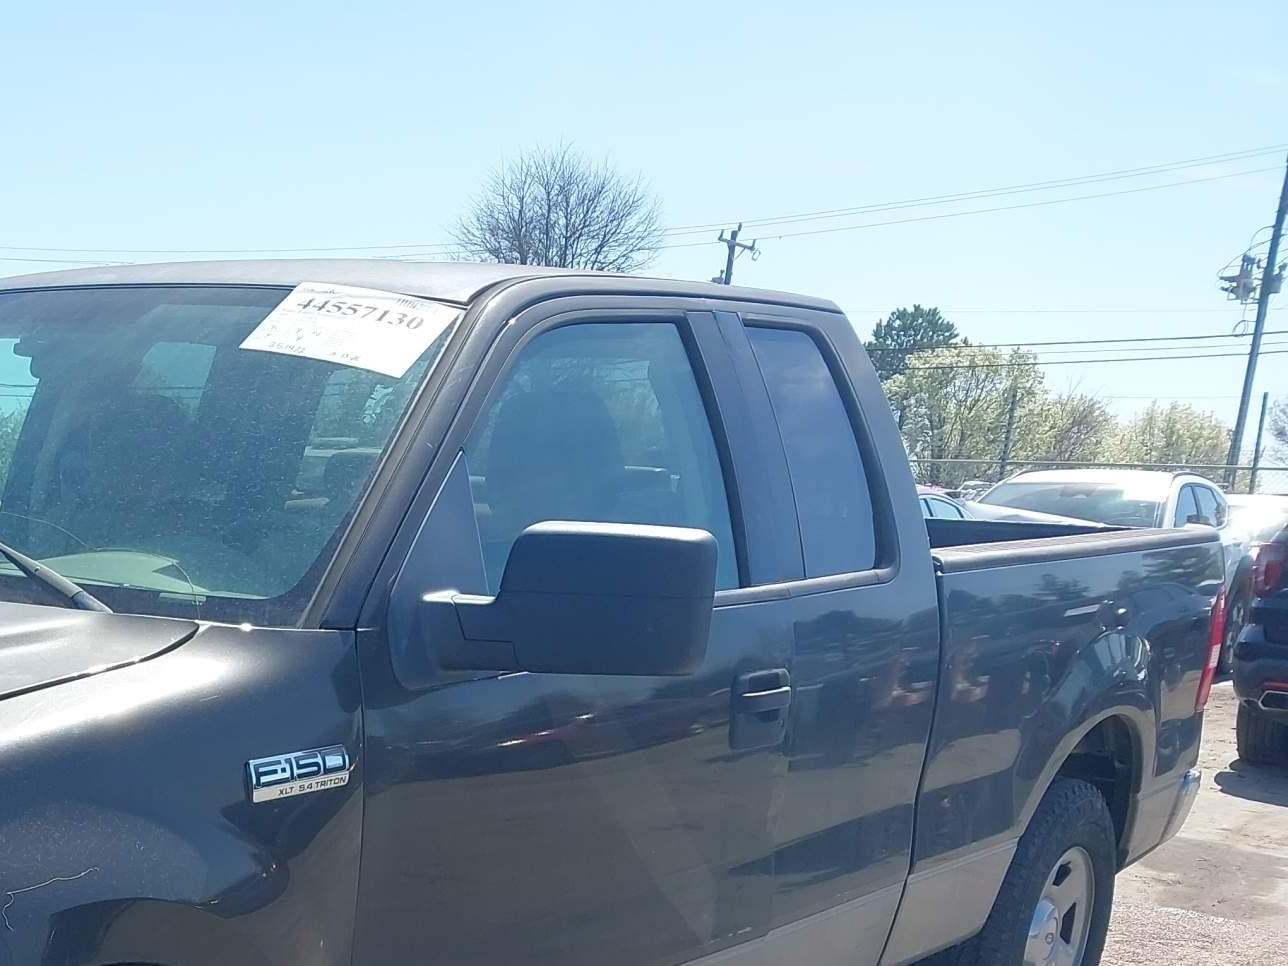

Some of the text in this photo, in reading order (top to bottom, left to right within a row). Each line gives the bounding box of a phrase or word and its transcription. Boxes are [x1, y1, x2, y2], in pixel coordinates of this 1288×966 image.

[297, 298, 424, 330] 44557130
[252, 749, 349, 789] F-150
[278, 786, 294, 797] XLT
[315, 776, 347, 789] TRITON
